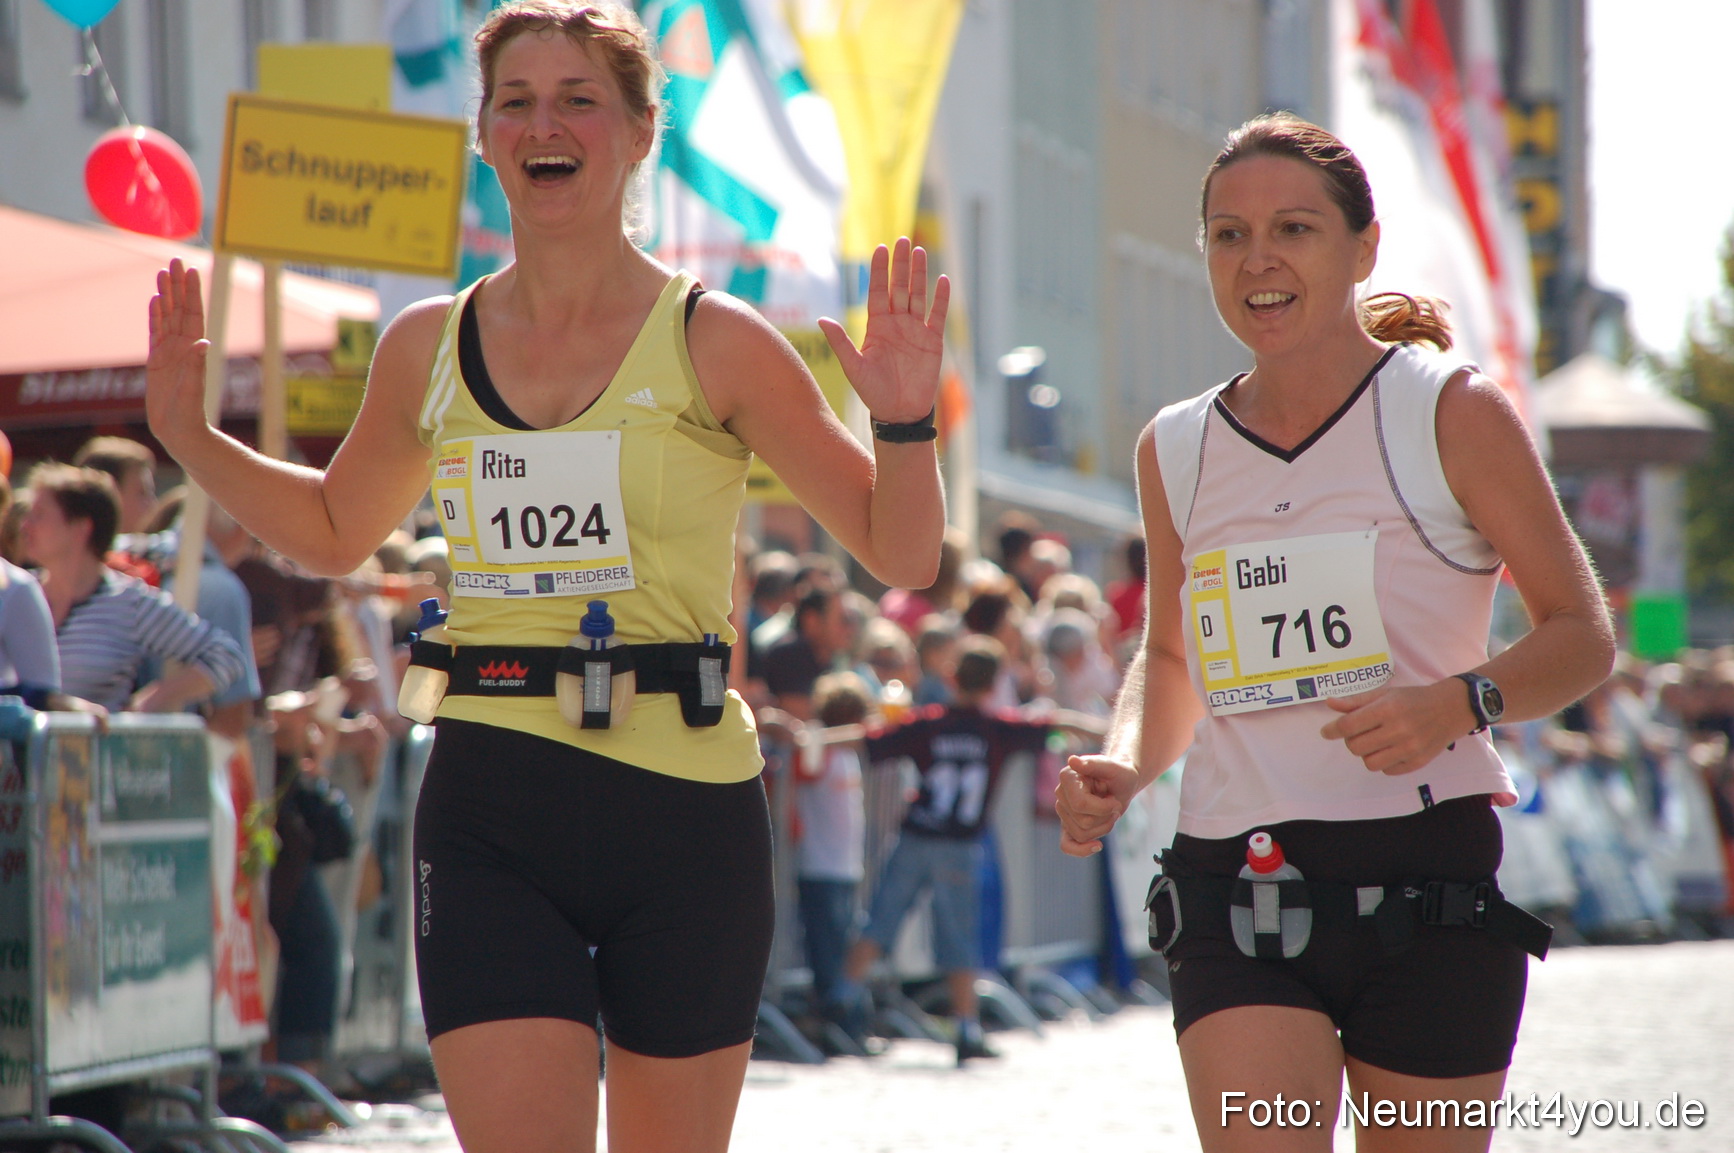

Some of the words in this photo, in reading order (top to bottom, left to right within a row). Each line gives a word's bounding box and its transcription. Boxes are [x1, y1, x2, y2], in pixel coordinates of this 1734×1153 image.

[241, 140, 446, 191] Schnupper-
[305, 193, 373, 227] lauf
[625, 396, 658, 409] adidas
[482, 450, 526, 479] Rita
[443, 500, 455, 520] D
[1274, 501, 1291, 513] JS
[491, 503, 611, 549] 1024
[455, 572, 511, 589] BOCK
[556, 566, 629, 584] PFLEIDERER
[1236, 555, 1287, 590] Gabi
[557, 580, 632, 593] AKTIENGESELLSCHAFT
[1201, 615, 1213, 637] D
[1261, 604, 1352, 658] 716
[479, 679, 527, 687] FUEL-BUDDY
[1316, 663, 1391, 689] PFLEIDERER
[1320, 674, 1394, 697] AKTIENGESELLSCHA
[1210, 684, 1274, 707] BOCK
[422, 882, 432, 937] odlo
